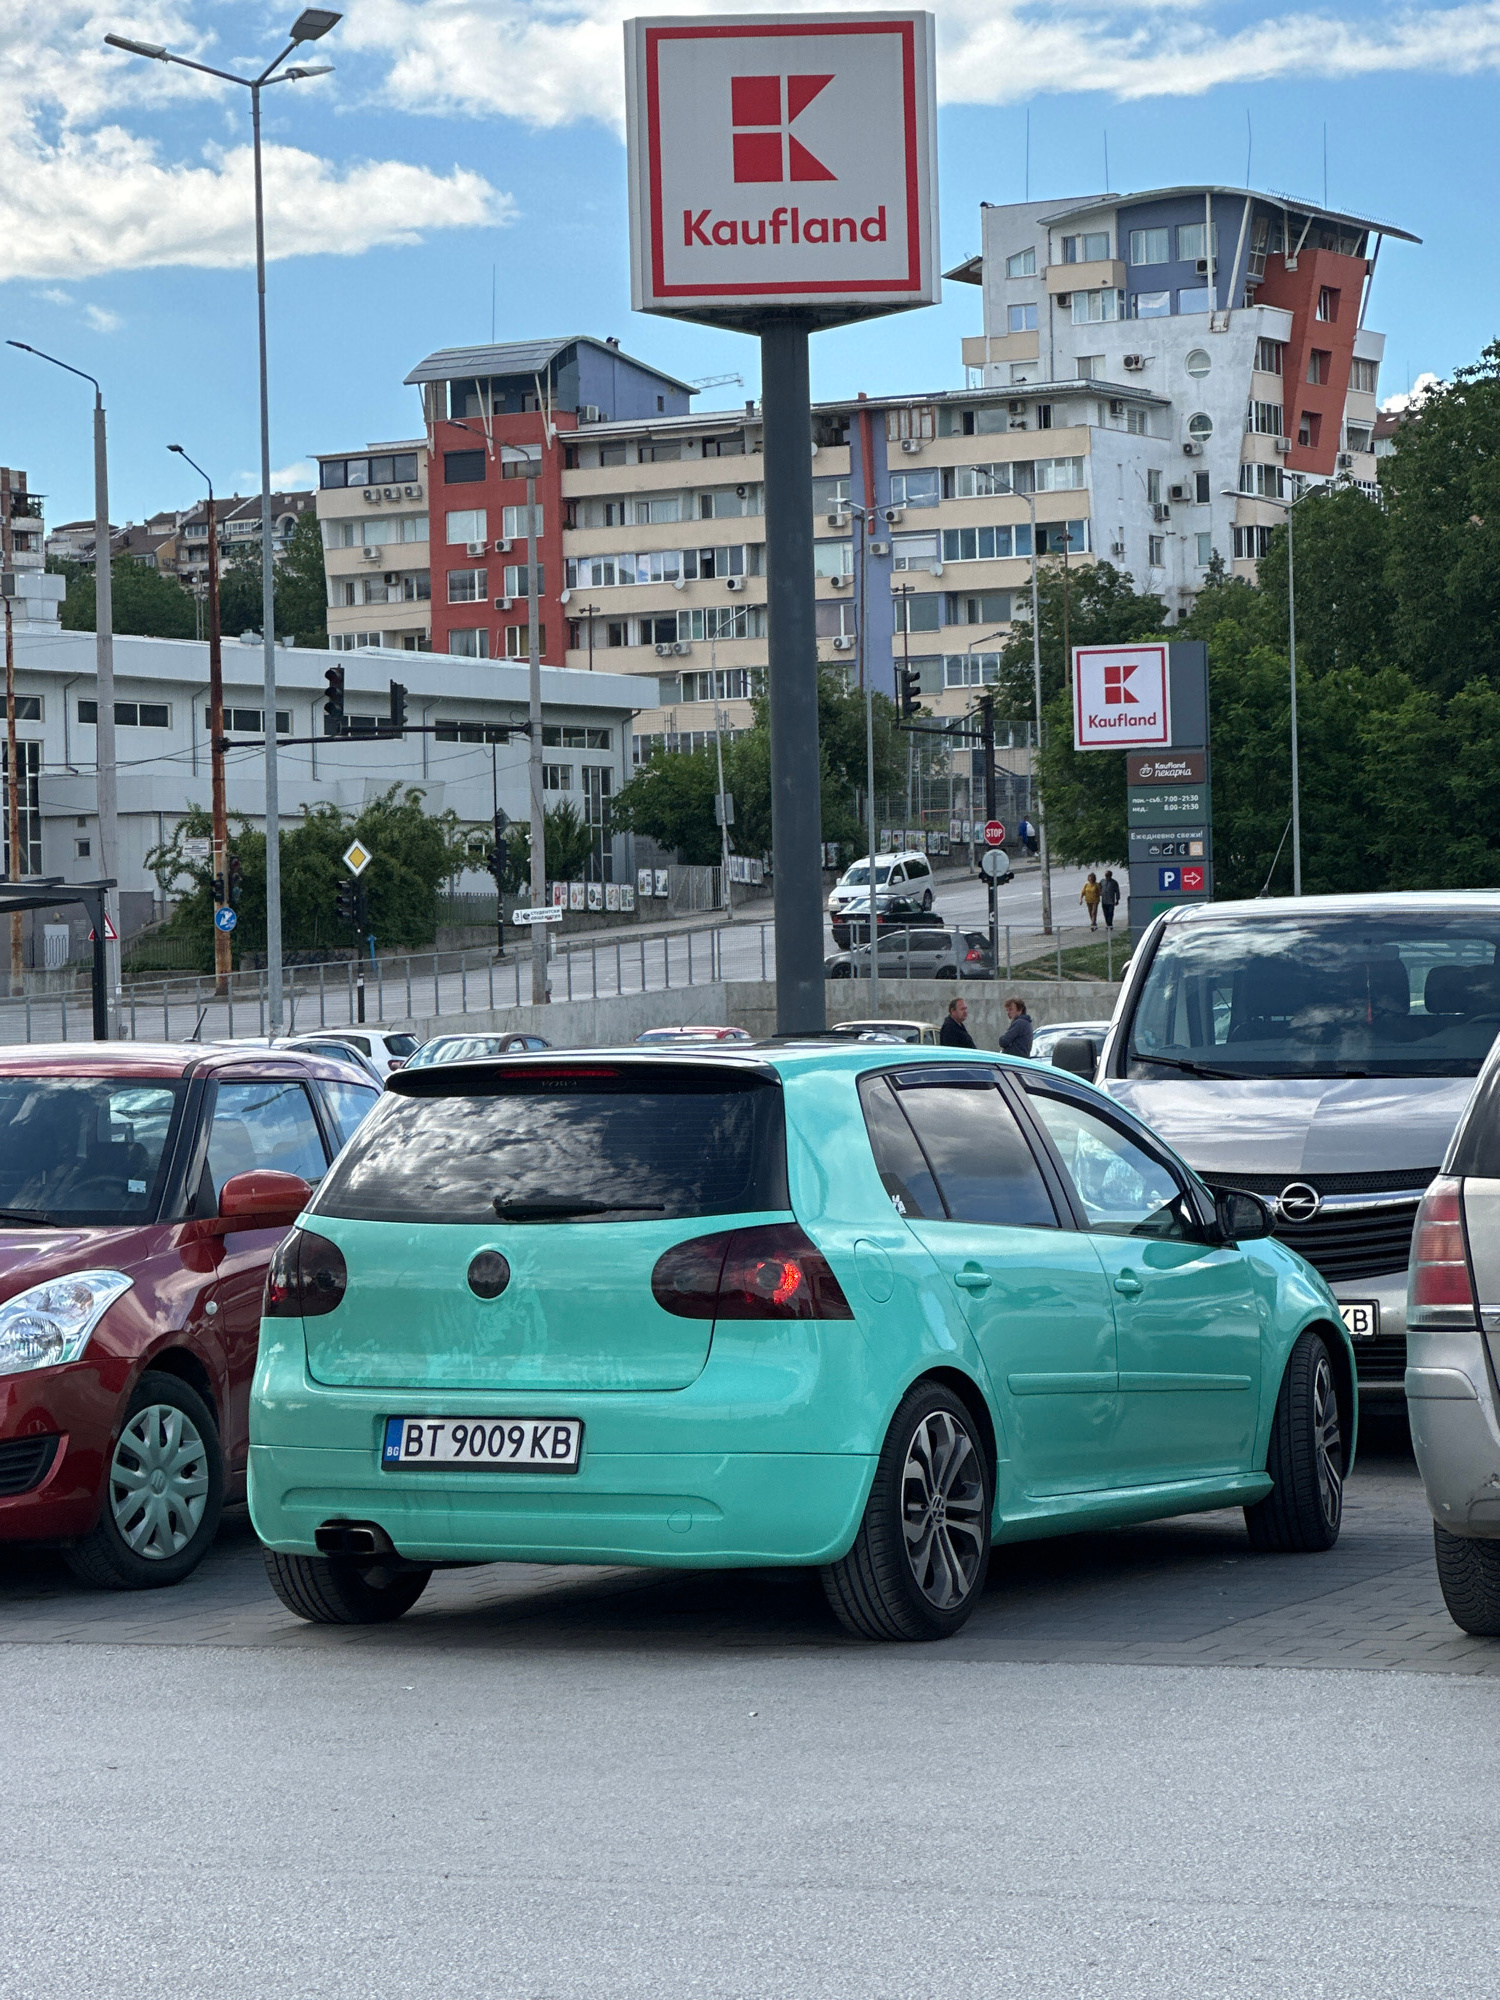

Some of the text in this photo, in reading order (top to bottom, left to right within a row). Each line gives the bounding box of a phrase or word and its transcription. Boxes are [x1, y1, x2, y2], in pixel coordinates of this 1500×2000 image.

[683, 205, 887, 246] Kaufland
[1088, 712, 1157, 728] Kaufland
[1154, 761, 1186, 769] Kaufland
[986, 828, 1003, 838] STOP
[1130, 829, 1203, 840] Ежедневно свежи!
[1164, 871, 1175, 888] P
[386, 1424, 572, 1459] BG BT 9009 KB
